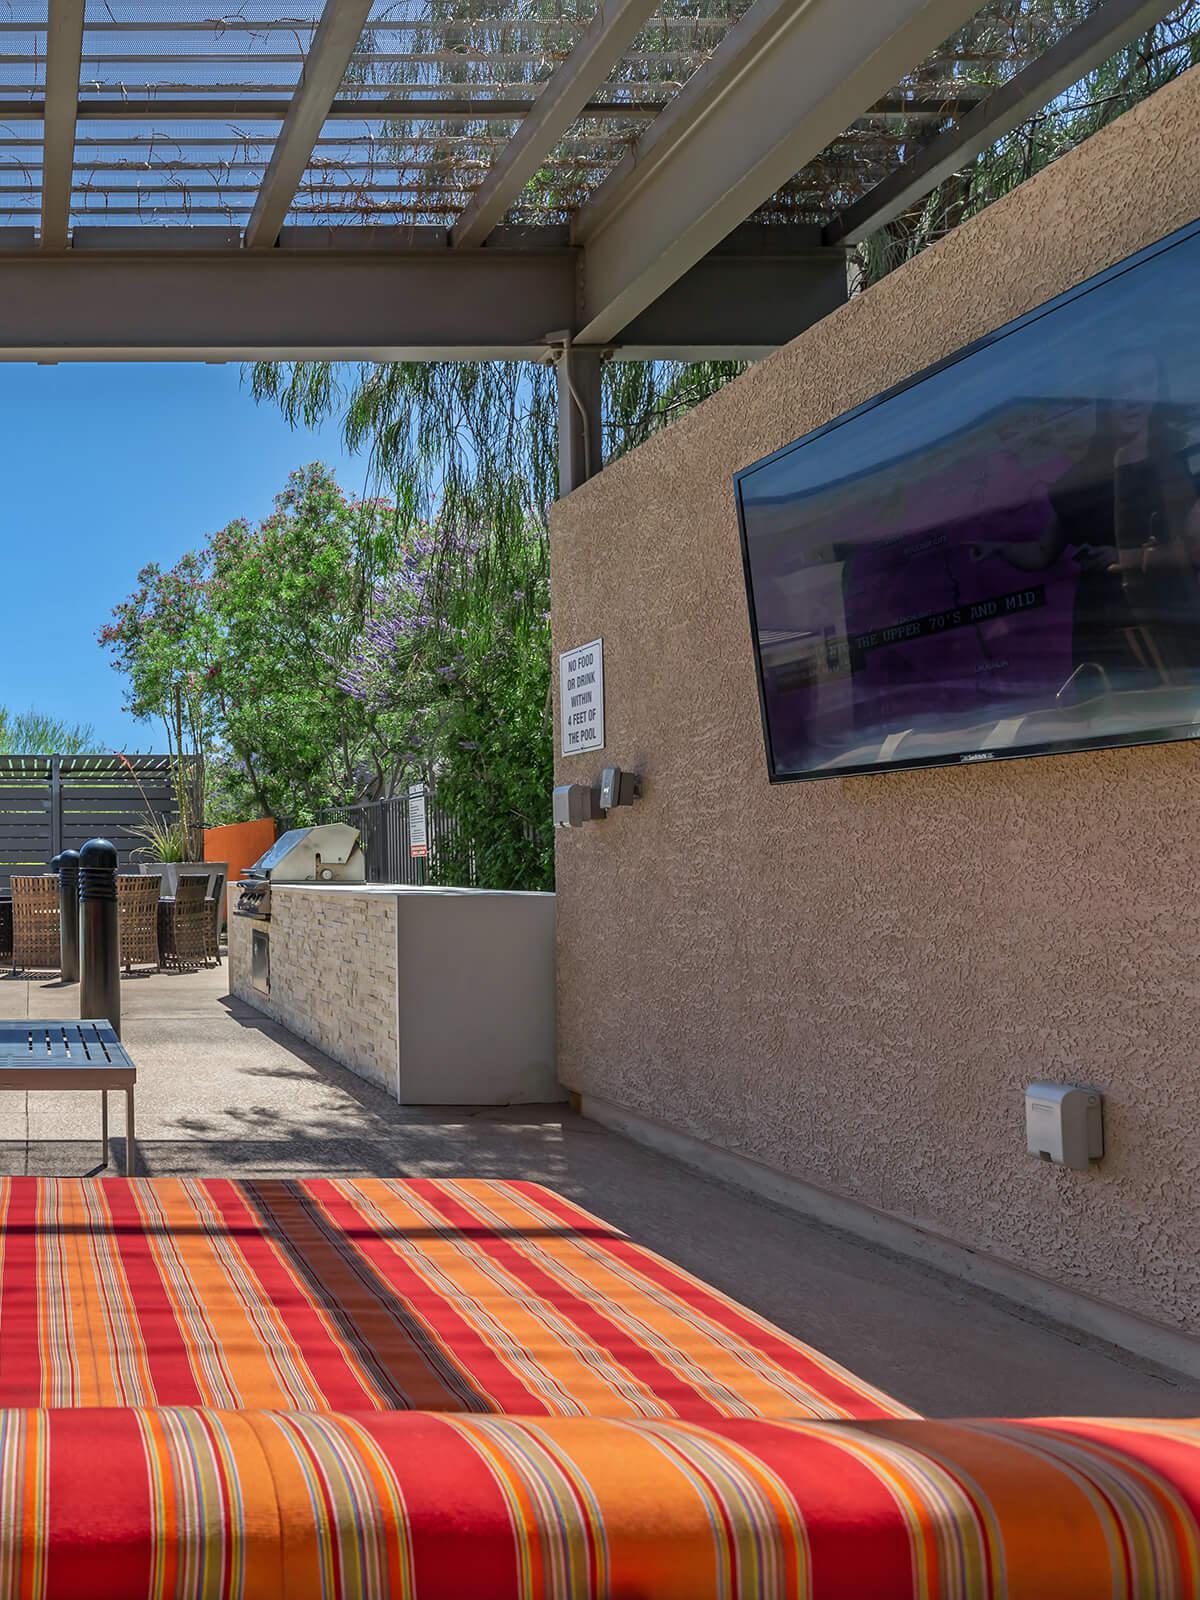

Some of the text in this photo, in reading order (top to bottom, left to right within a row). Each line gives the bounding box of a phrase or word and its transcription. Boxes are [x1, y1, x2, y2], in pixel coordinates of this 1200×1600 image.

[855, 633, 880, 649] THE
[882, 621, 921, 642] UPPER
[970, 602, 998, 620] AND
[568, 653, 593, 672] NO FOOD
[567, 671, 596, 690] OR DRINK
[571, 691, 592, 707] WITHIN
[568, 708, 596, 726] 4 FEET OF
[568, 728, 596, 745] THE POOL
